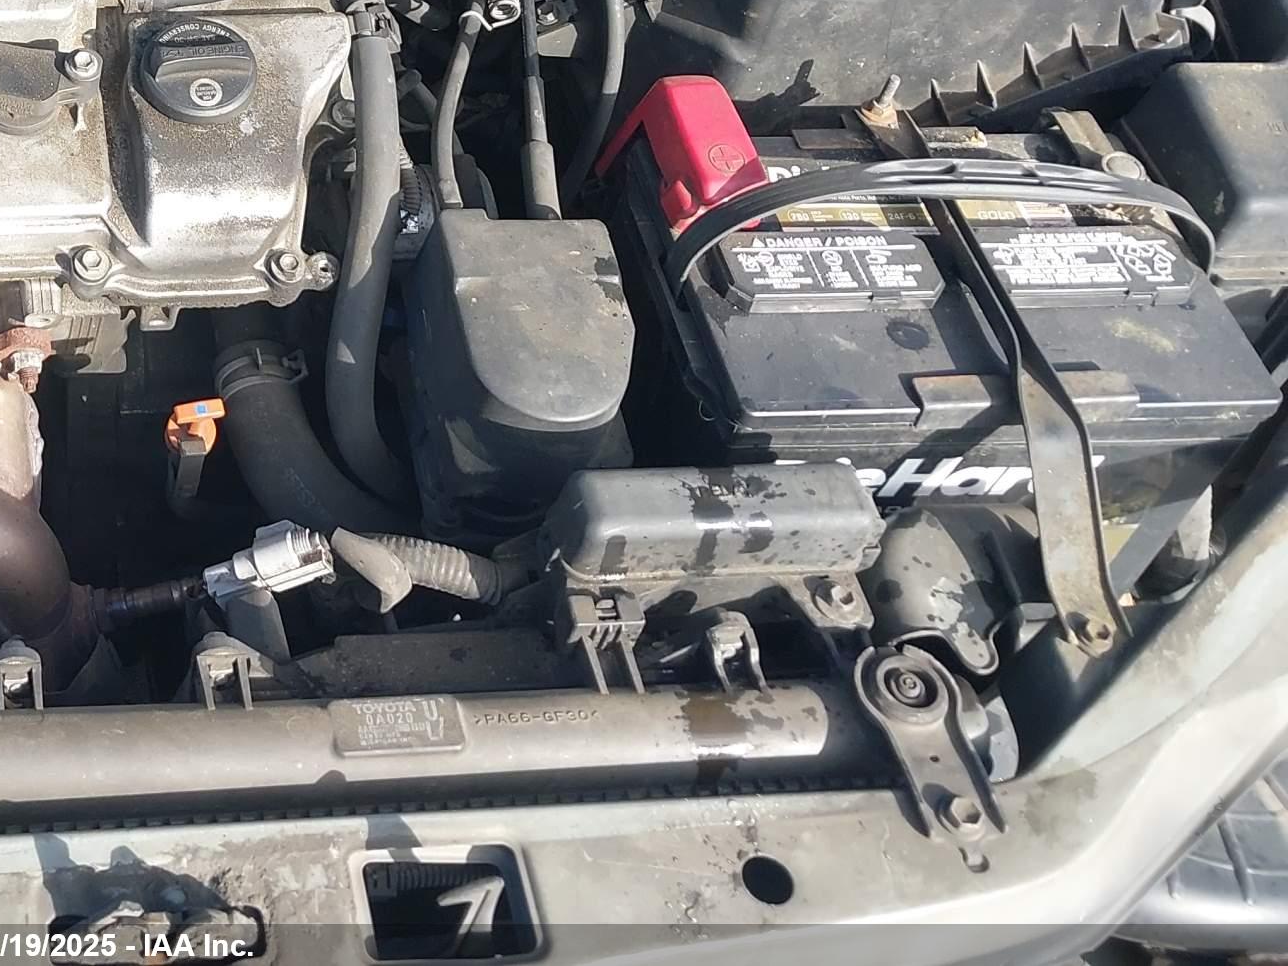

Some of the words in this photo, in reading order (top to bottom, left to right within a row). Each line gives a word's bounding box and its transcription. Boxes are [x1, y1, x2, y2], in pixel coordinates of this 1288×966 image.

[188, 47, 206, 56] OIL
[207, 44, 245, 56] ENGINE
[977, 209, 1016, 221] GOLD
[765, 237, 823, 248] DANGER
[836, 235, 888, 246] POISON
[352, 700, 417, 714] TOYOTA
